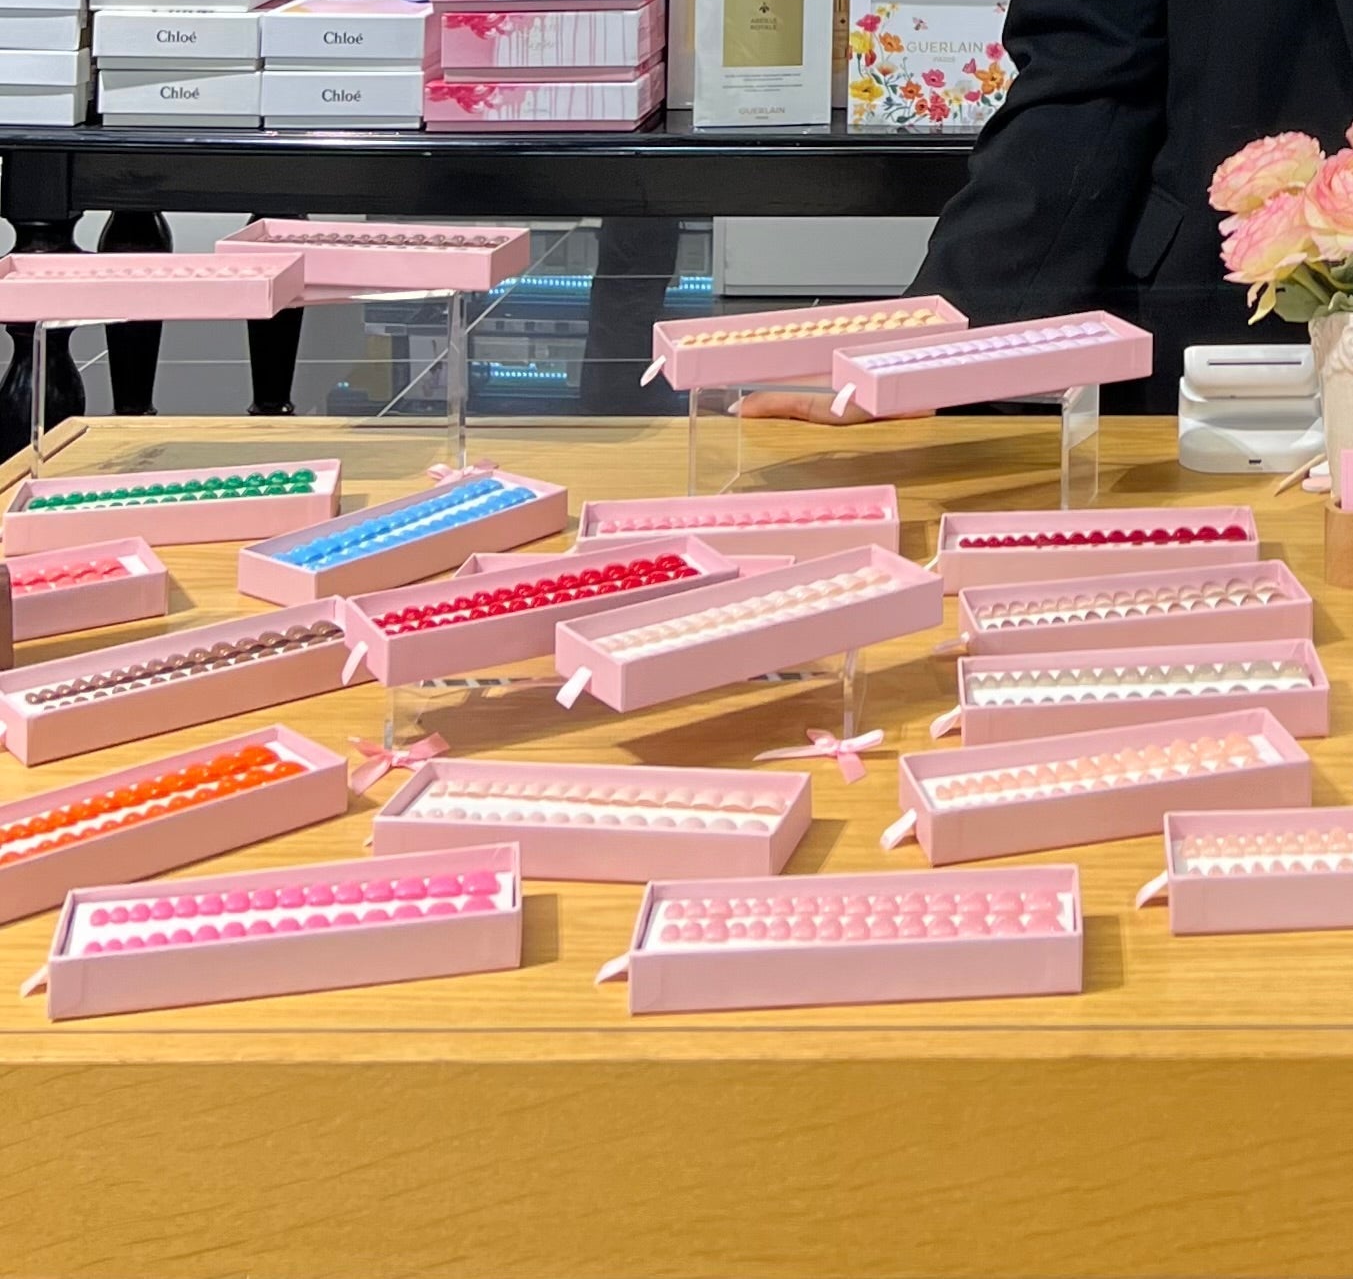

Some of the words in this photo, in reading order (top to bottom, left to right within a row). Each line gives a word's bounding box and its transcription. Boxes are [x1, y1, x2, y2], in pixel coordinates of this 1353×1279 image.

[156, 29, 197, 44] Chloé
[323, 30, 364, 45] Chloé
[907, 41, 983, 53] GUERLAIN
[159, 86, 200, 100] Chloé
[321, 88, 362, 103] Chloé
